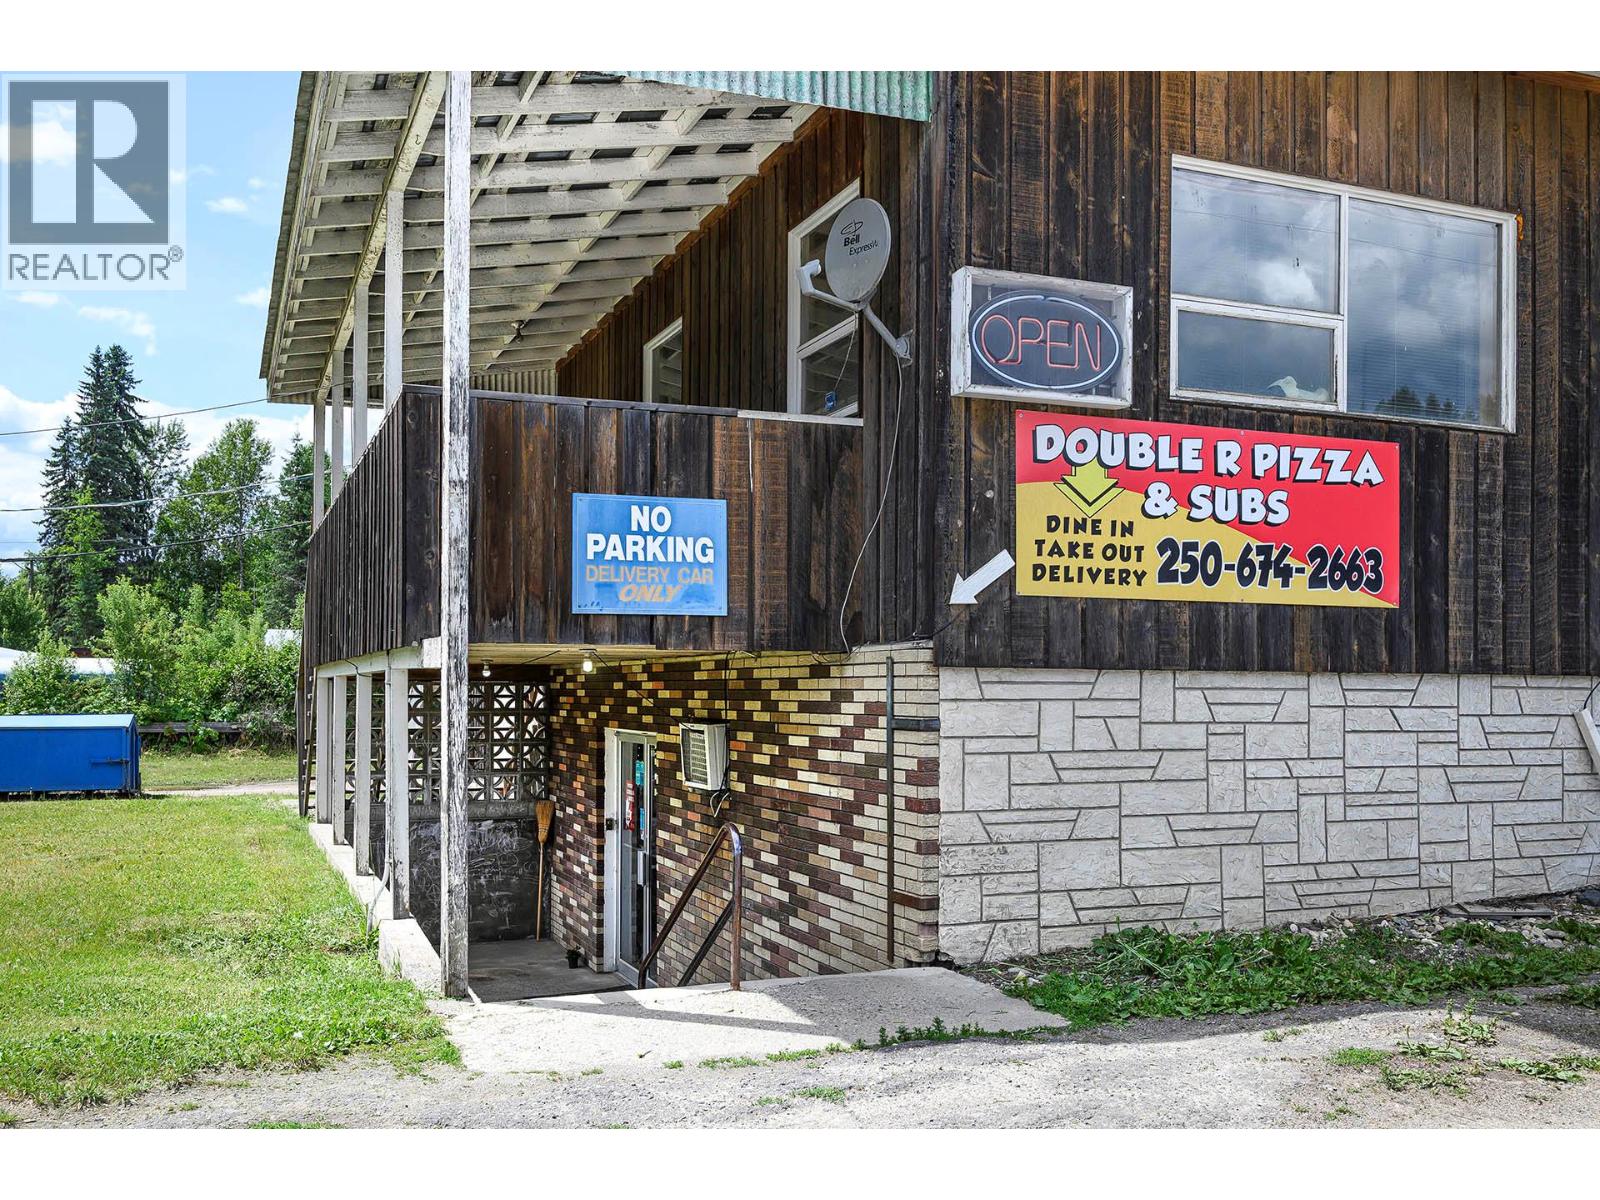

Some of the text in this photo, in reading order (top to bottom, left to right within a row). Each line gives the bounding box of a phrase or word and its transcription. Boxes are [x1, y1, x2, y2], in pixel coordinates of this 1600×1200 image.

[843, 234, 860, 247] Bell
[981, 314, 1101, 371] OPEN
[1033, 424, 1385, 487] DOUBLE R PIZZA
[1141, 481, 1290, 526] & SUBS
[630, 505, 672, 532] NO
[1046, 515, 1134, 537] DINE IN
[586, 533, 714, 563] PARKING
[1034, 539, 1145, 562] TAKE OUT
[586, 565, 713, 584] DELIVERY CAR
[1032, 563, 1147, 586] DELIVERY
[1156, 536, 1384, 594] 250-674-2663
[618, 584, 682, 602] ONLY
